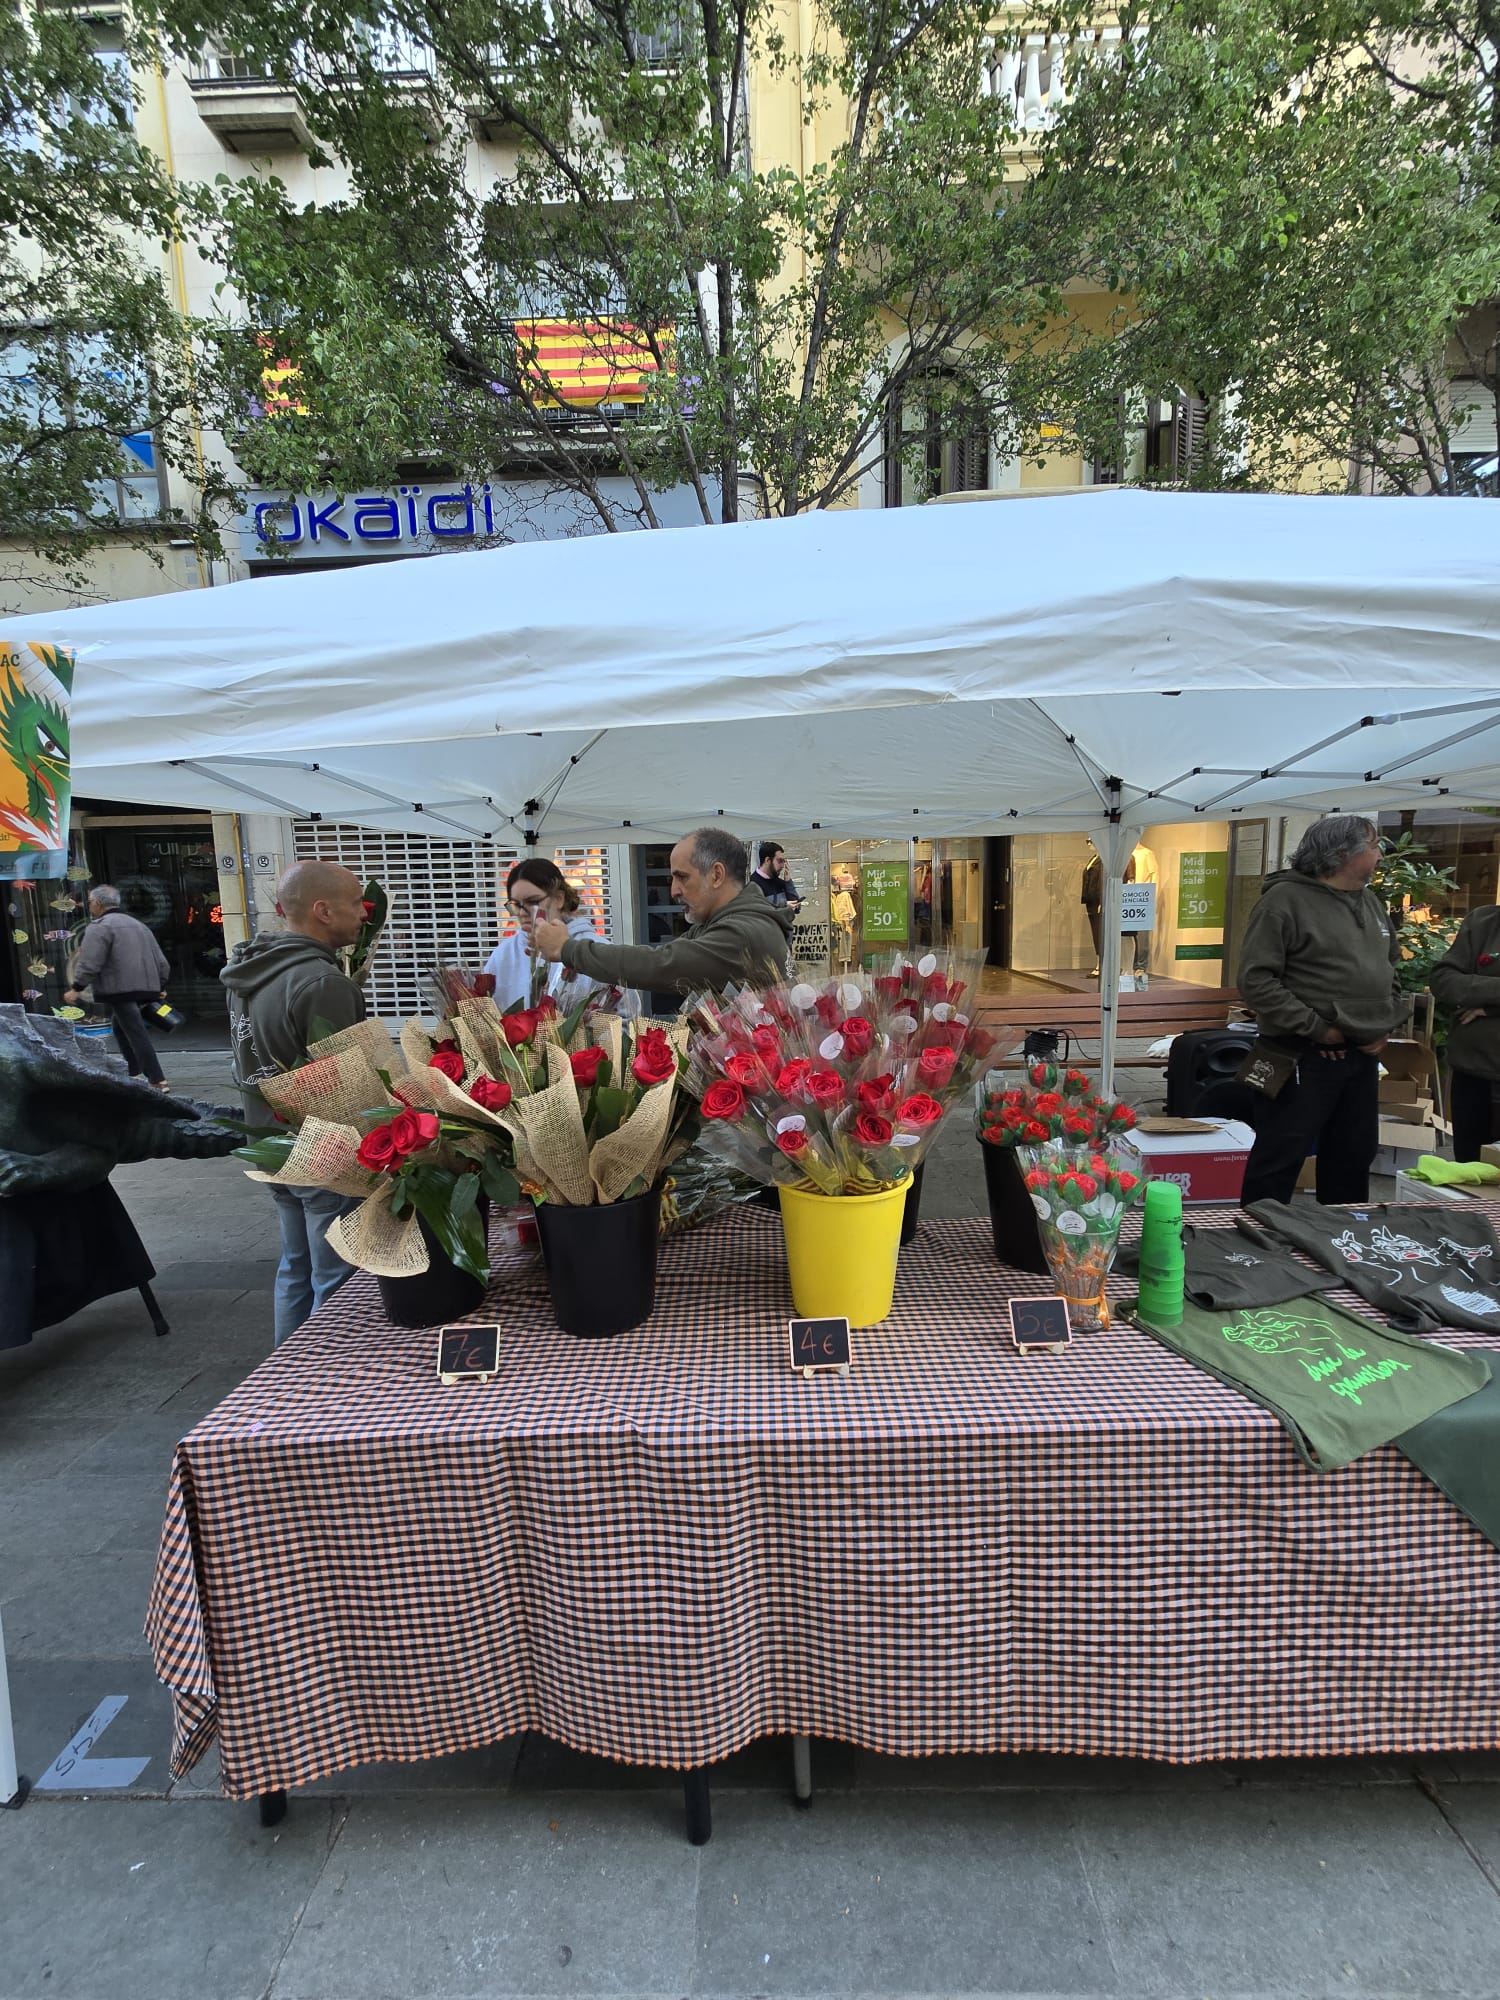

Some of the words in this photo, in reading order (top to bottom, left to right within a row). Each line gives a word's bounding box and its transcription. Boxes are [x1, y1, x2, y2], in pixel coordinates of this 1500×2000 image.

[1183, 856, 1204, 866] Mid
[866, 869, 886, 879] Mid
[1183, 867, 1219, 876] season
[866, 880, 901, 888] season
[1183, 876, 1204, 885] sale
[866, 887, 886, 897] sale
[794, 944, 828, 953] CONTRA
[444, 1333, 487, 1369] 7€
